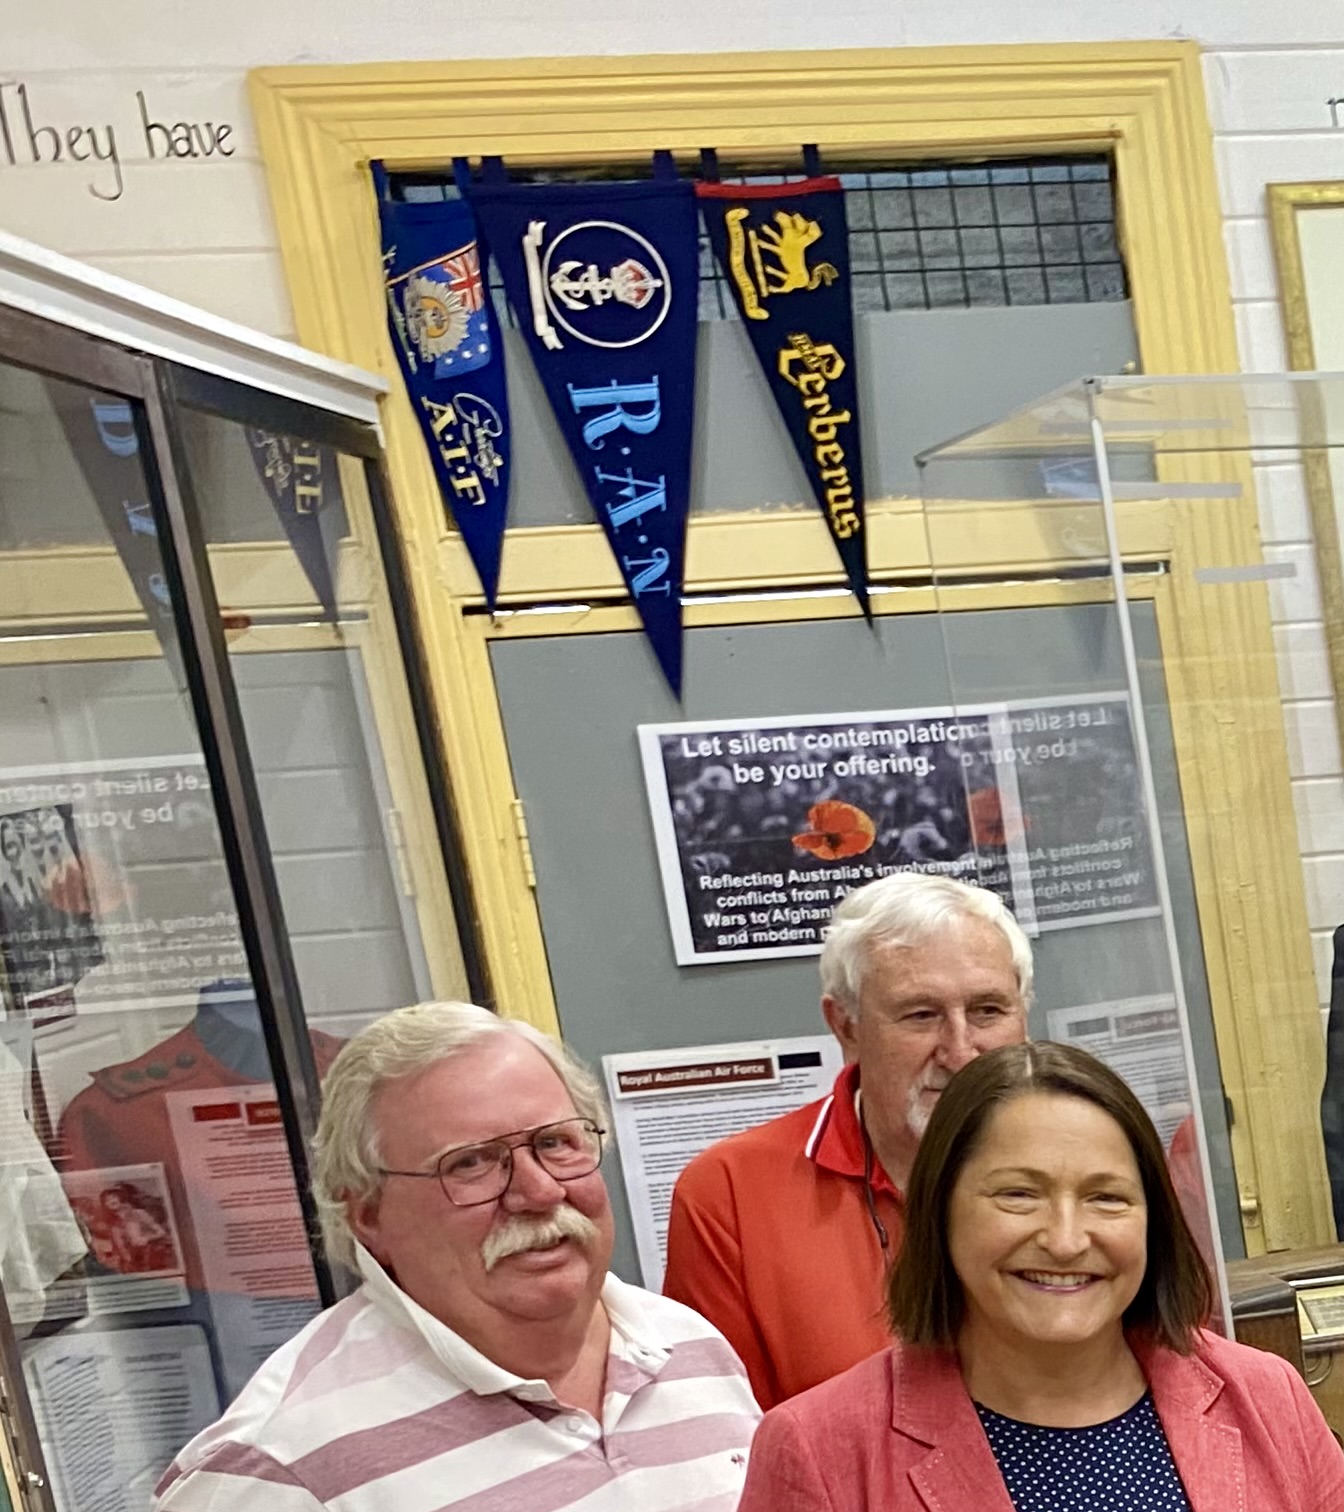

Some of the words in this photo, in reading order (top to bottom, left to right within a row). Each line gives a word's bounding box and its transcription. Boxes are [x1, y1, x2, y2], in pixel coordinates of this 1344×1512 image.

[0, 81, 123, 201] They
[136, 90, 236, 160] have
[682, 735, 723, 758] Let
[729, 731, 797, 755] silent
[733, 762, 765, 783] be
[770, 761, 828, 786] your
[834, 754, 936, 777] offering.
[700, 870, 784, 890] Reflecting
[788, 863, 873, 885] Australia's
[716, 892, 787, 908] conflicts
[792, 888, 830, 903] from
[704, 912, 747, 928] Wars
[750, 909, 769, 925] to
[772, 904, 835, 925] Afghani
[717, 928, 749, 947] and
[753, 925, 816, 943] modern
[620, 1071, 653, 1087] Royal
[655, 1067, 713, 1083] Australian
[714, 1064, 731, 1077] Air
[733, 1062, 765, 1075] Force
